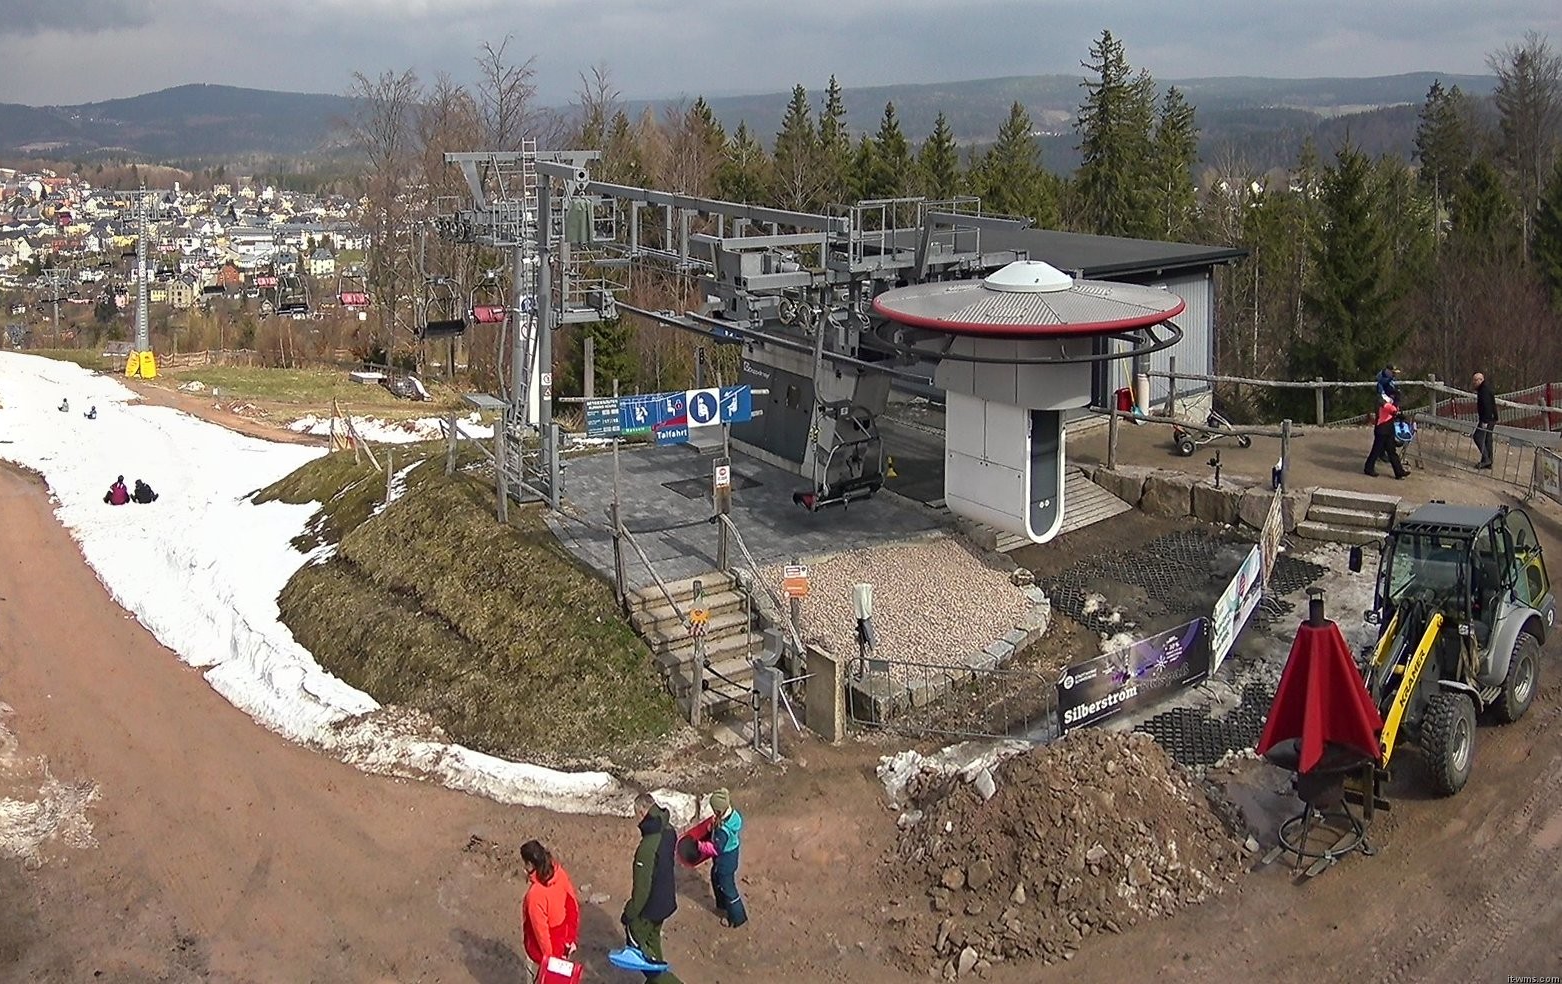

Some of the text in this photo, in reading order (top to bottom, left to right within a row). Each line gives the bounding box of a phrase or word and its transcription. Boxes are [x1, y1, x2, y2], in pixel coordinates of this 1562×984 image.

[657, 429, 687, 440] Talfahrt
[1399, 649, 1425, 708] KRAMER
[1064, 685, 1138, 725] Silberstrom
